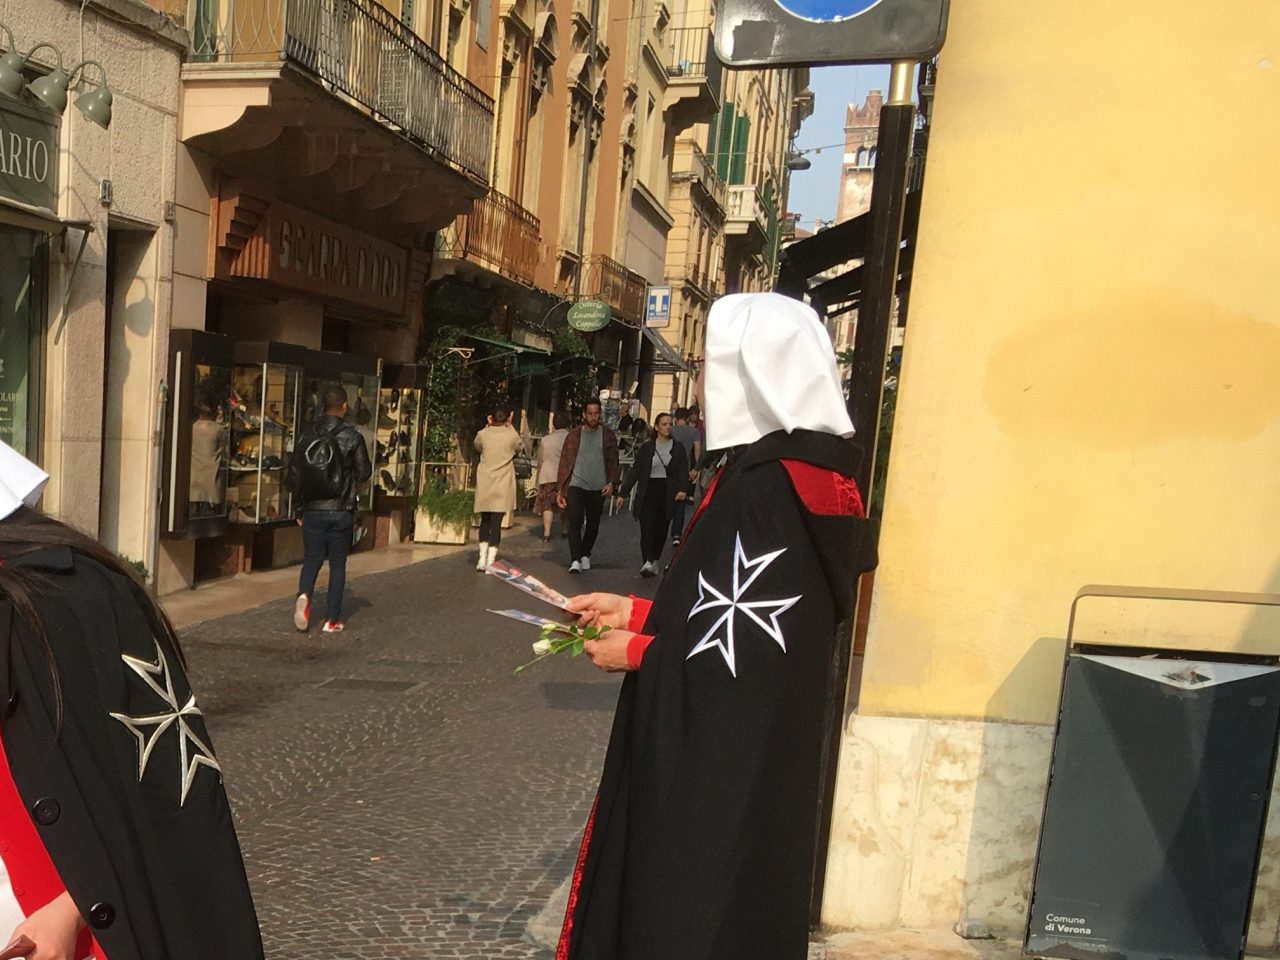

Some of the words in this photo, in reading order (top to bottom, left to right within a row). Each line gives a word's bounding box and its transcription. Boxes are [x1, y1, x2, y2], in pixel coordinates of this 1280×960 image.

[1046, 913, 1086, 924] Comune
[1045, 923, 1055, 931] di
[1058, 924, 1091, 935] Verona
